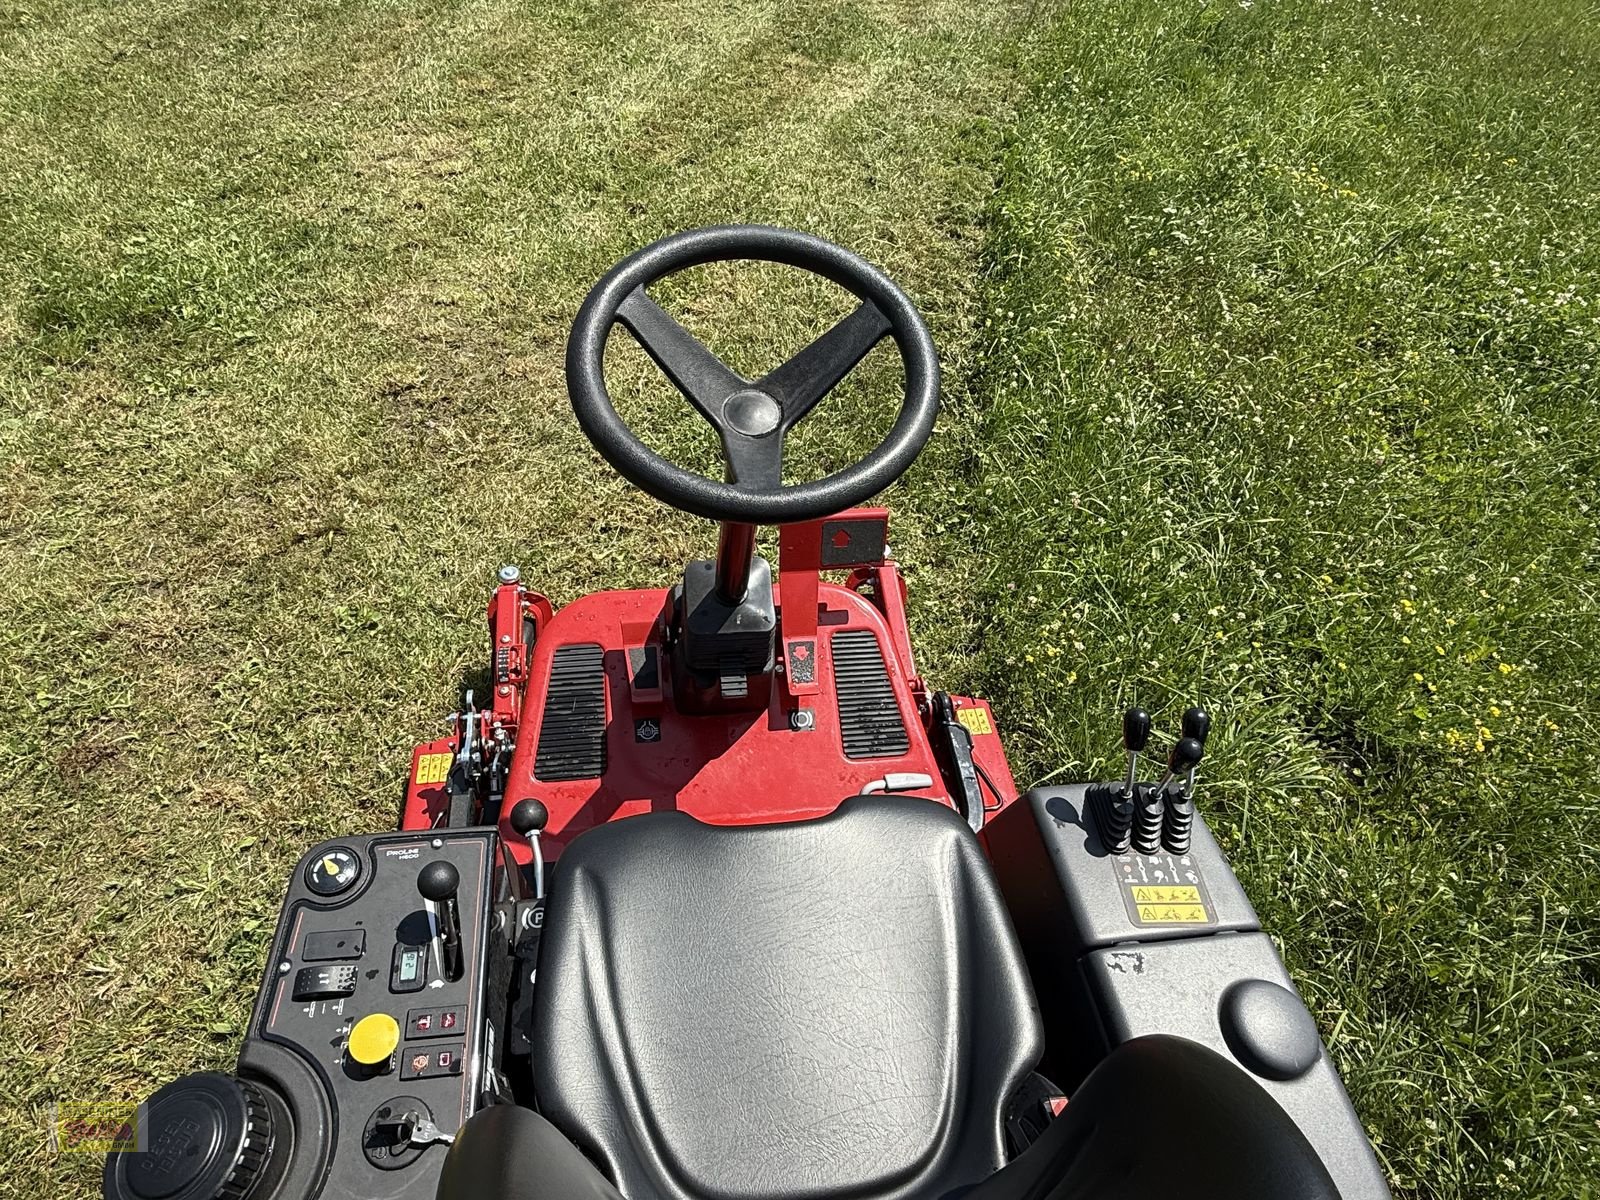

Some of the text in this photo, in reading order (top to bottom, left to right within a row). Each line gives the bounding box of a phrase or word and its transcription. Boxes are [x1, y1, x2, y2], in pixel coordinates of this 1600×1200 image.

[535, 912, 544, 924] P
[141, 1118, 186, 1171] DIESEL
[158, 1120, 200, 1174] DIESEL
